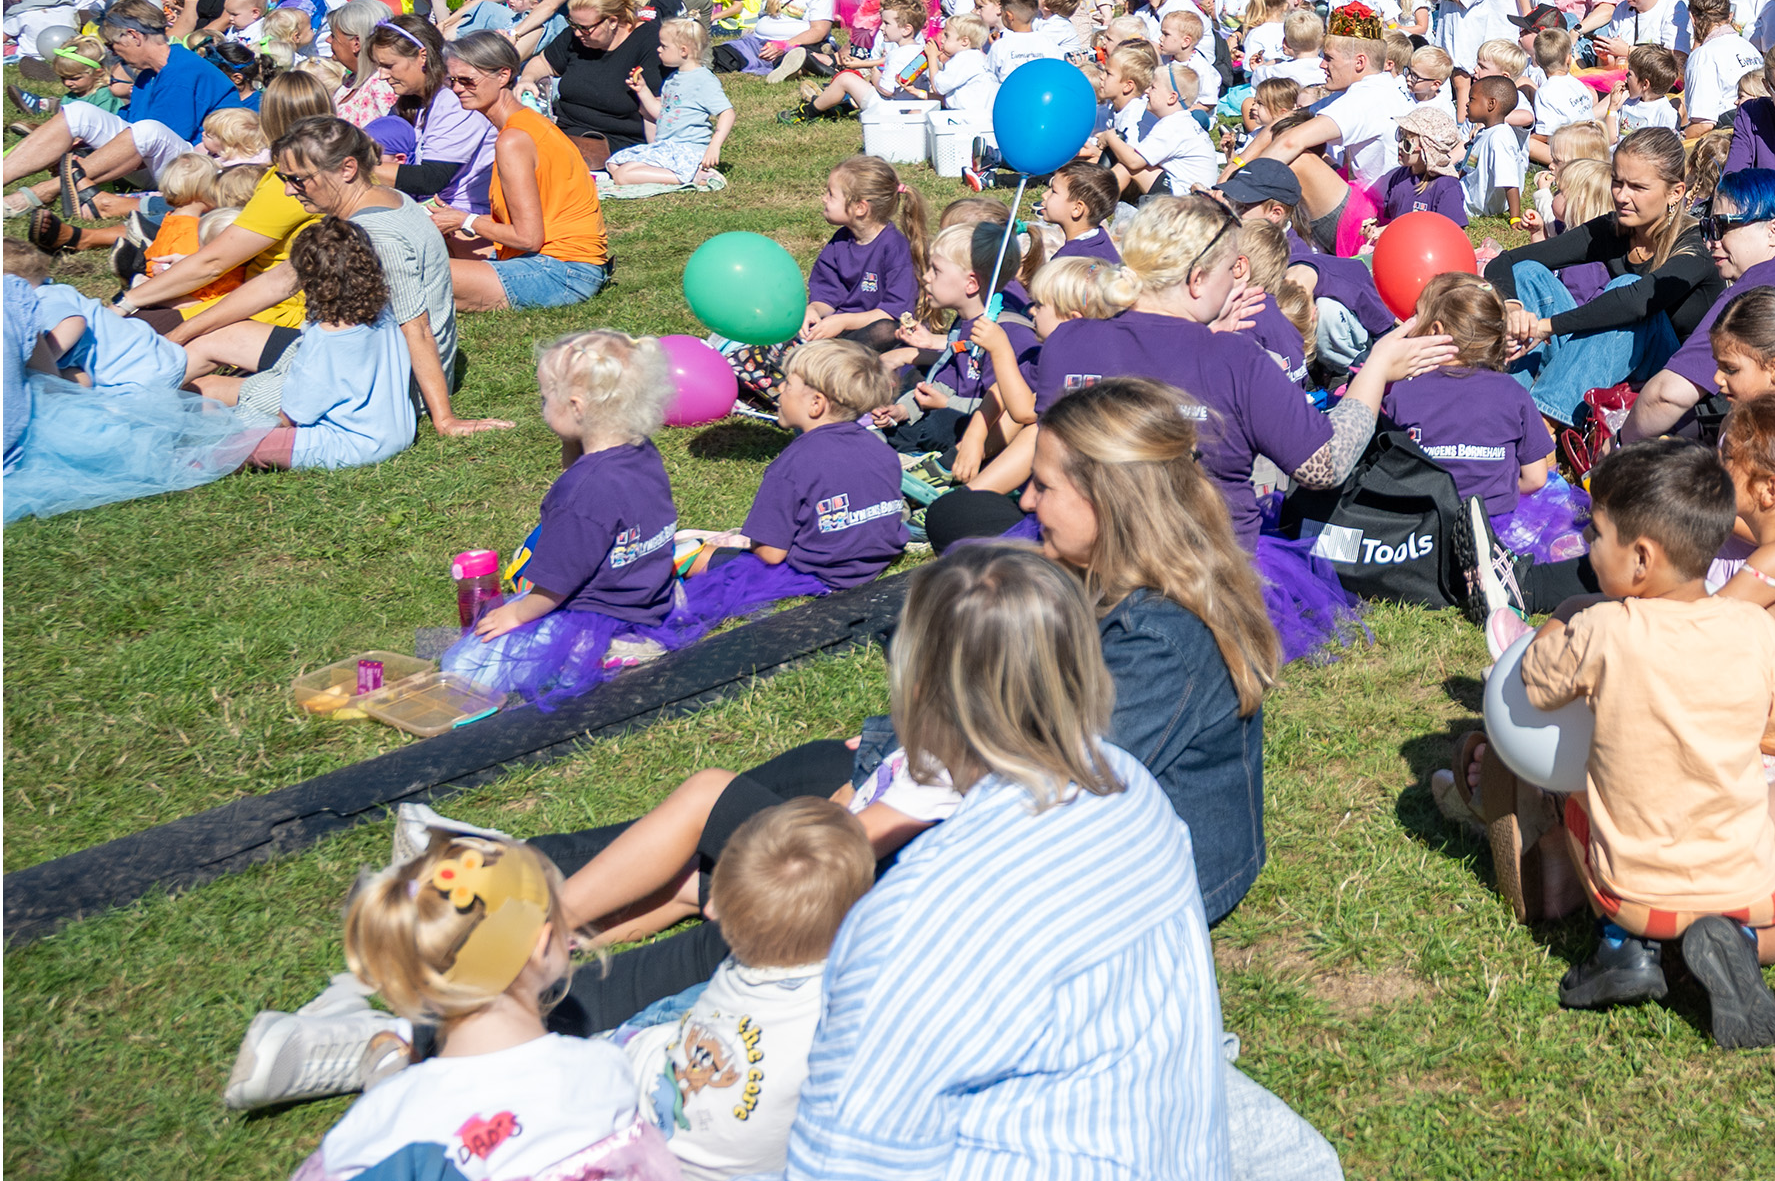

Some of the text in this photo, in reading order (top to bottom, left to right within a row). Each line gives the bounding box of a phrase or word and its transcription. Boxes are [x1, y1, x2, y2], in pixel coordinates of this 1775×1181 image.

[1458, 444, 1505, 458] BØRNEHAVE
[1361, 532, 1434, 564] Tools
[738, 1015, 764, 1065] the
